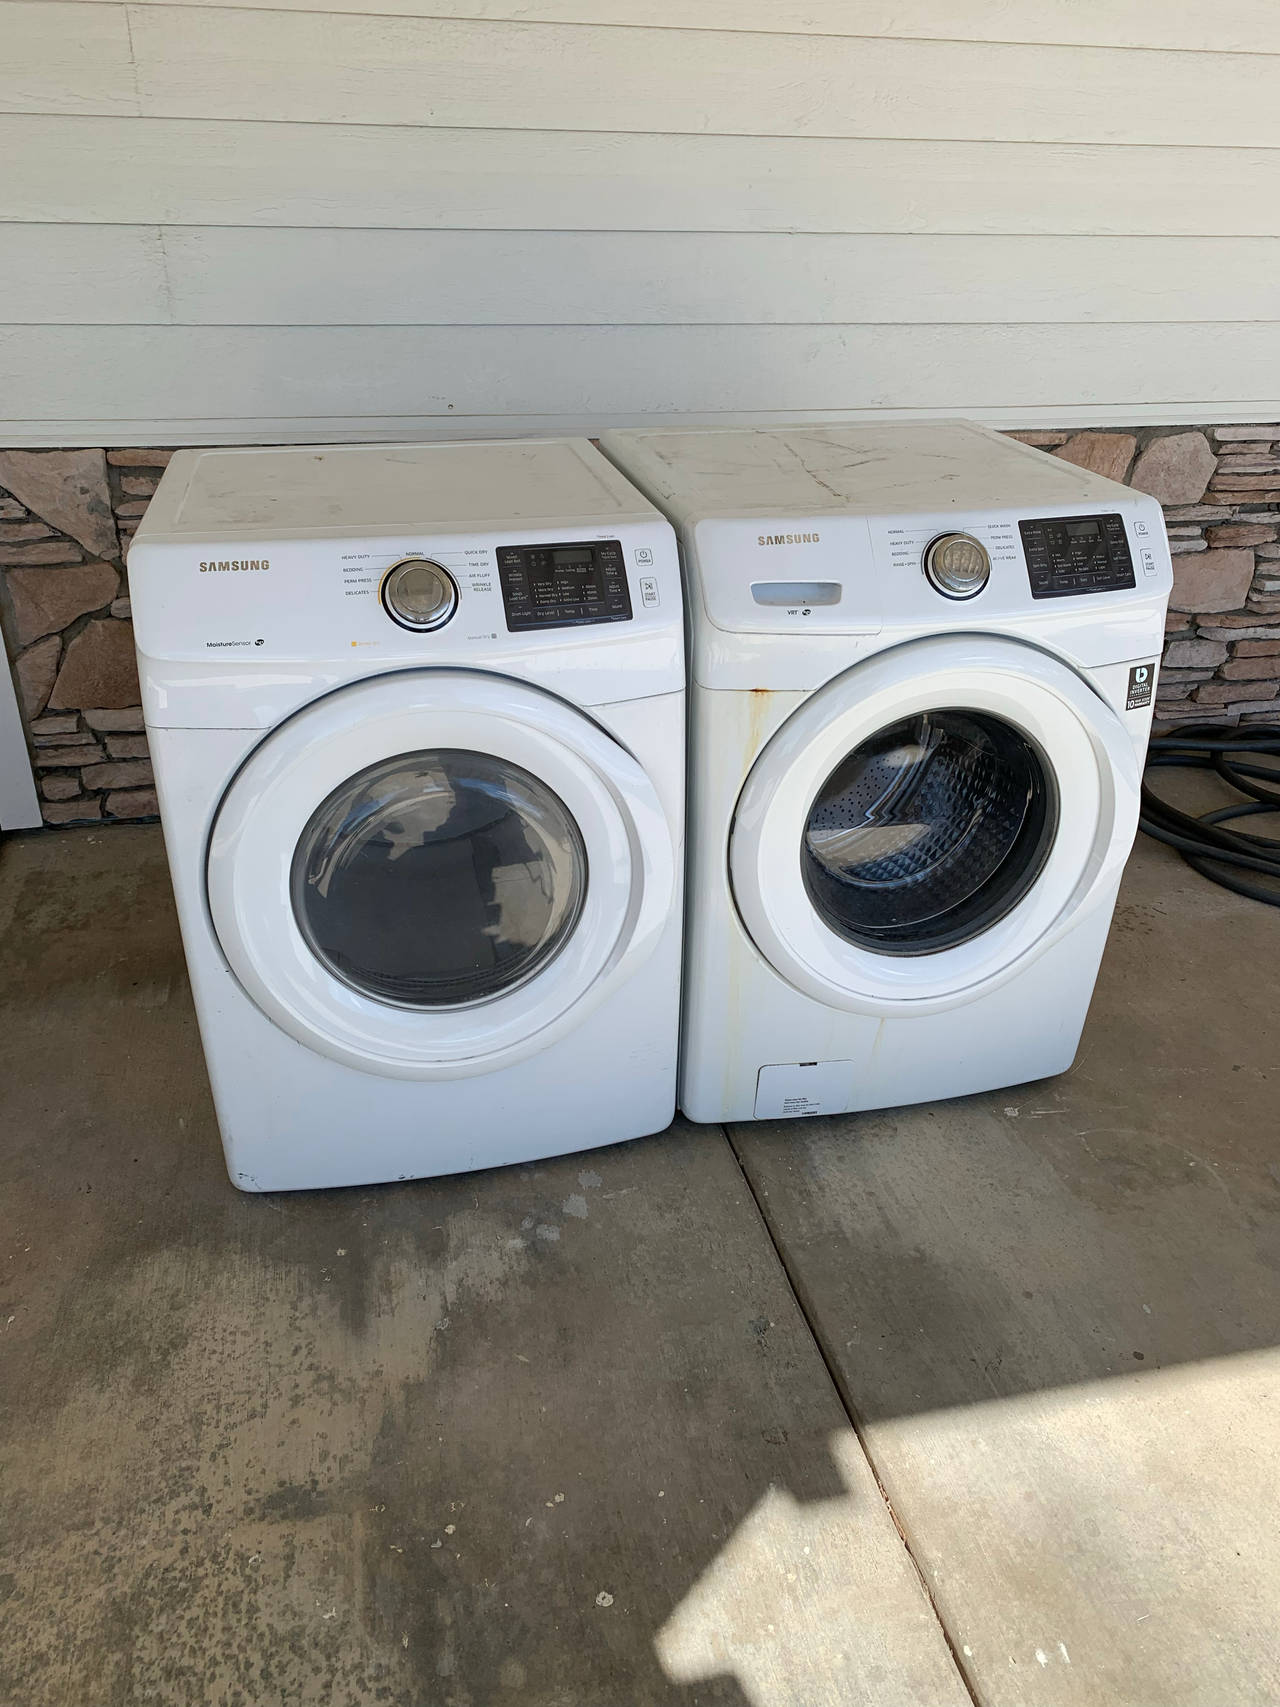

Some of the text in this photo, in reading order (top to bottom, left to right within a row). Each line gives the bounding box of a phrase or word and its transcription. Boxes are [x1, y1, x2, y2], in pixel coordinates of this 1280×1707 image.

[758, 533, 820, 546] SAMSUNG
[199, 560, 270, 573] SAMSUNG
[206, 640, 251, 648] MoistureSensor
